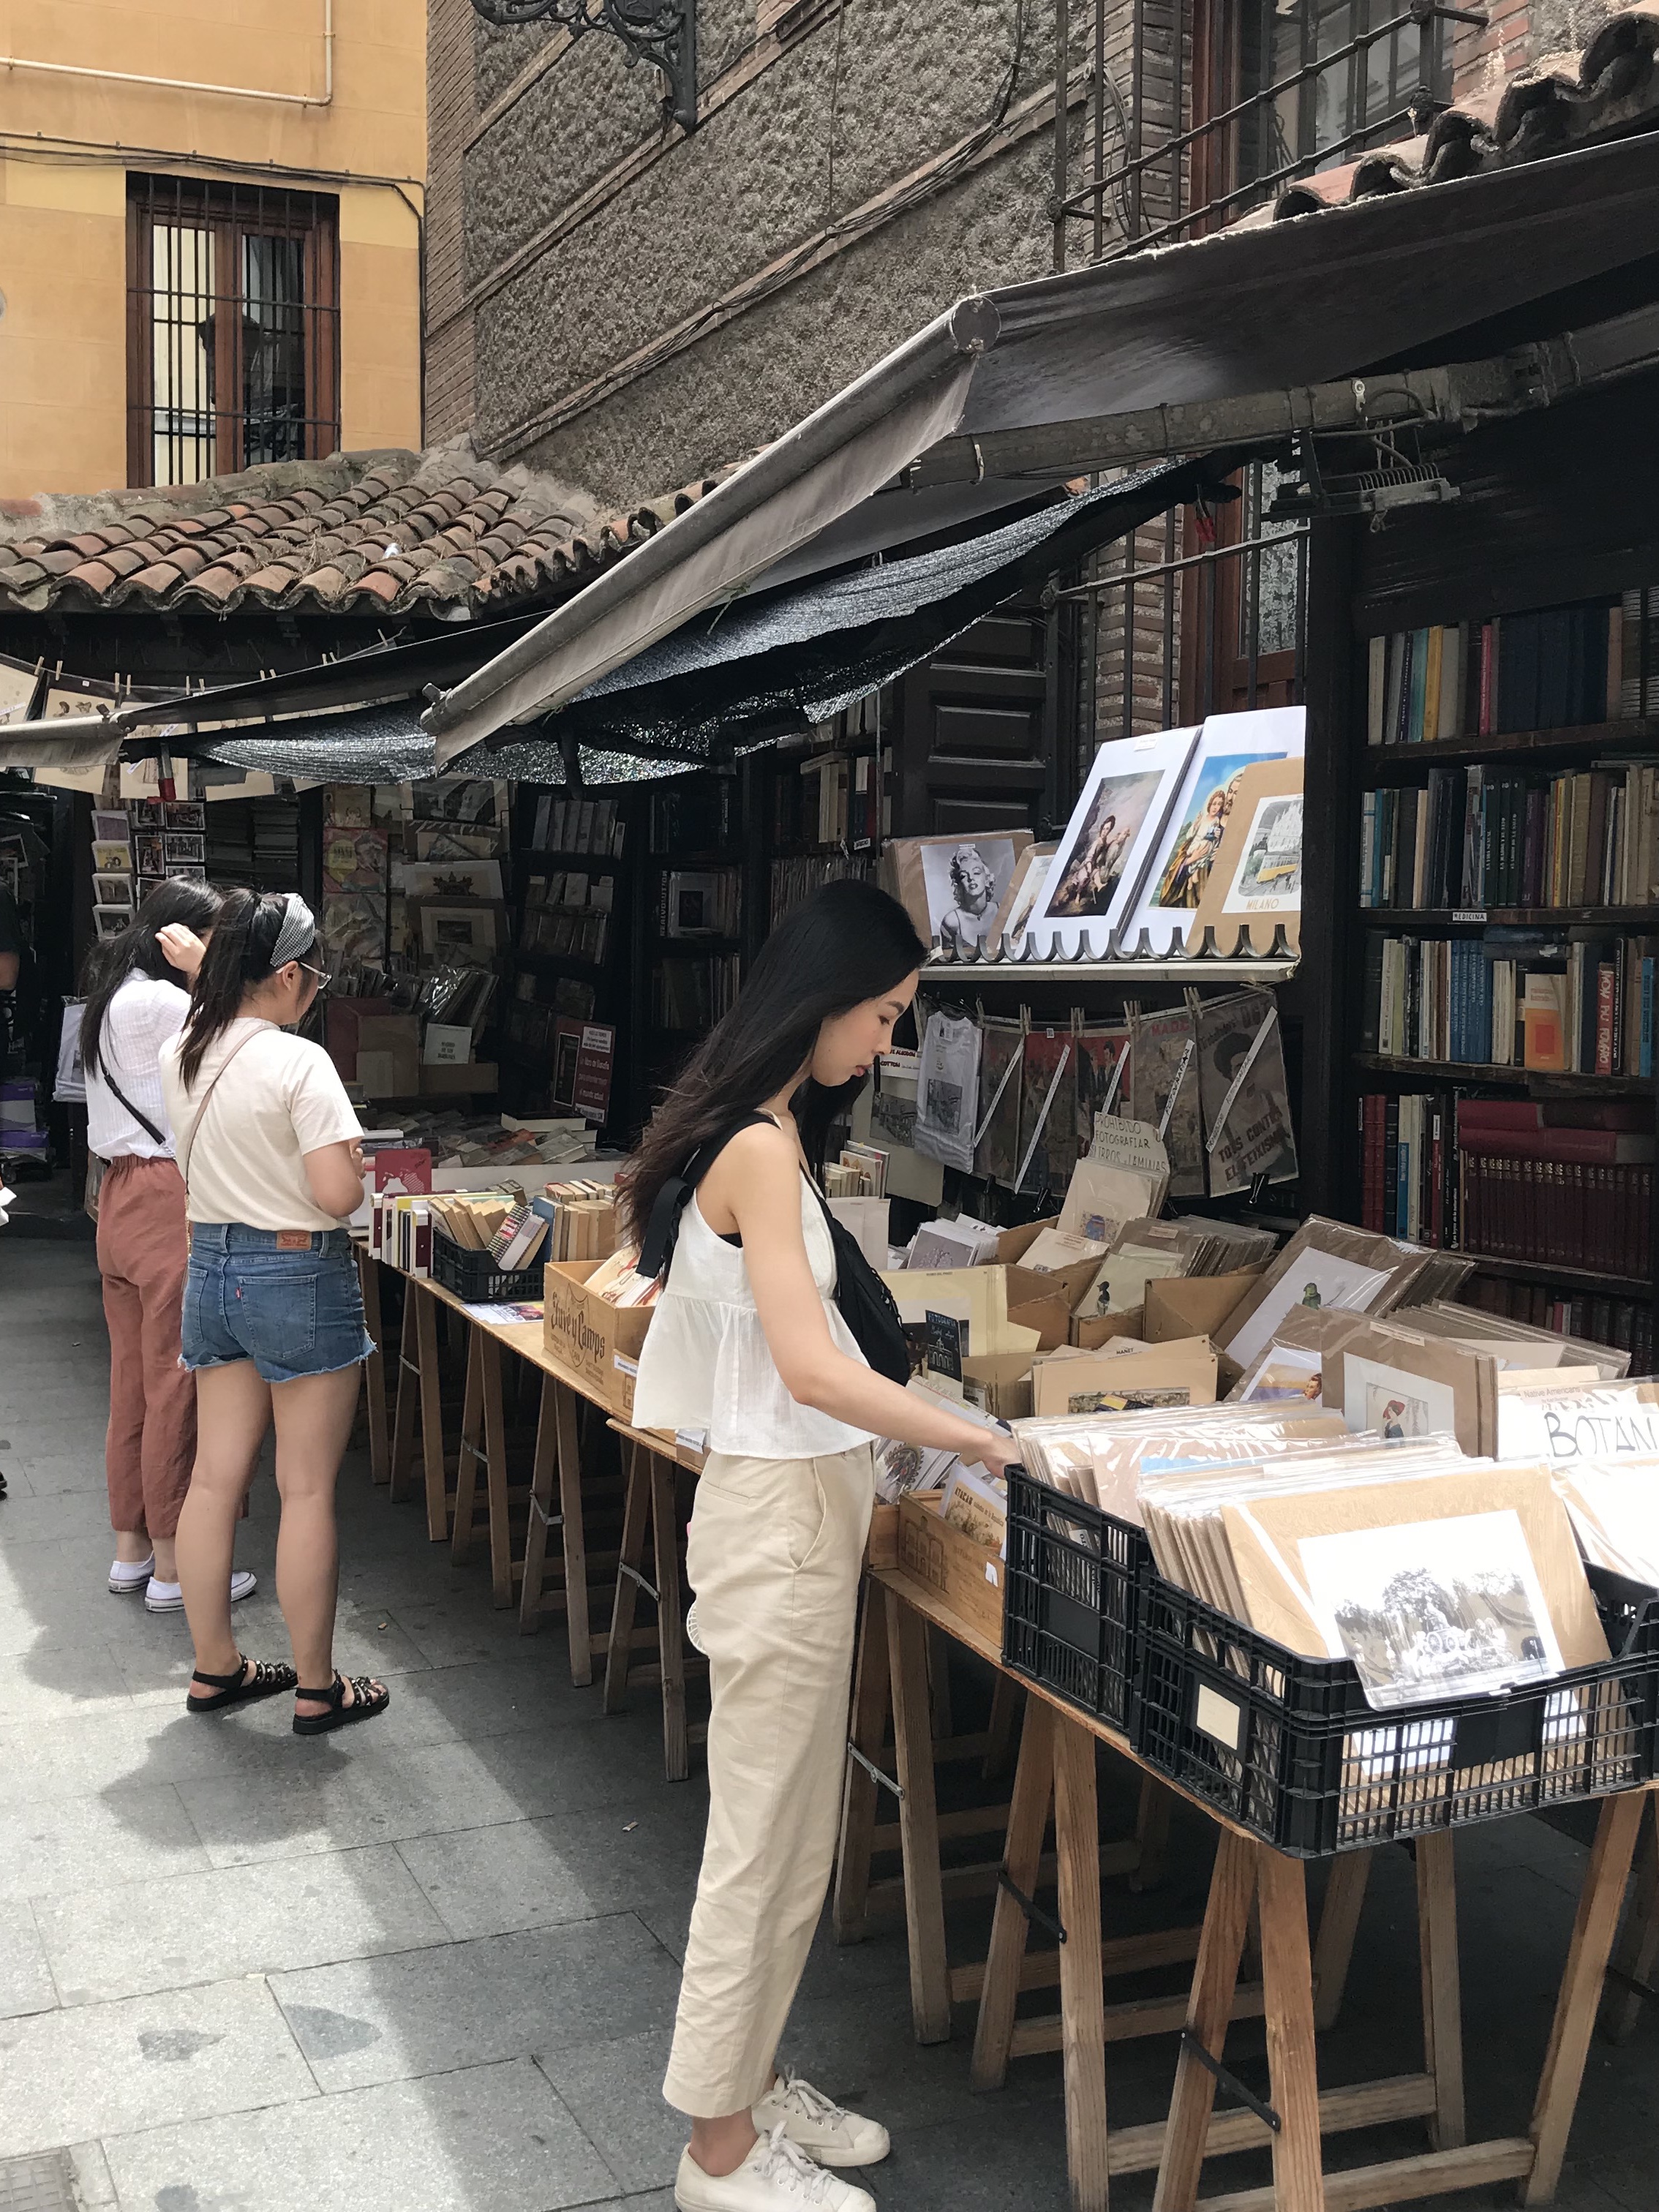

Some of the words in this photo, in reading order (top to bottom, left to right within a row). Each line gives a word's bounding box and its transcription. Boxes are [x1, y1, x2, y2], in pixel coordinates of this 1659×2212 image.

[1246, 898, 1279, 911] MILANO
[1453, 912, 1485, 920] MEDICINA
[1095, 1112, 1141, 1135] PROHIBIDO
[1095, 1129, 1151, 1149] FOTOGRAFIAR
[1218, 1136, 1244, 1163] TOS
[1246, 1110, 1283, 1142] CONT
[571, 1316, 578, 1347] y
[577, 1310, 605, 1364] Camps
[1524, 1390, 1546, 1399] Native
[1546, 1386, 1581, 1396] Americans
[954, 1486, 974, 1506] ATACAR
